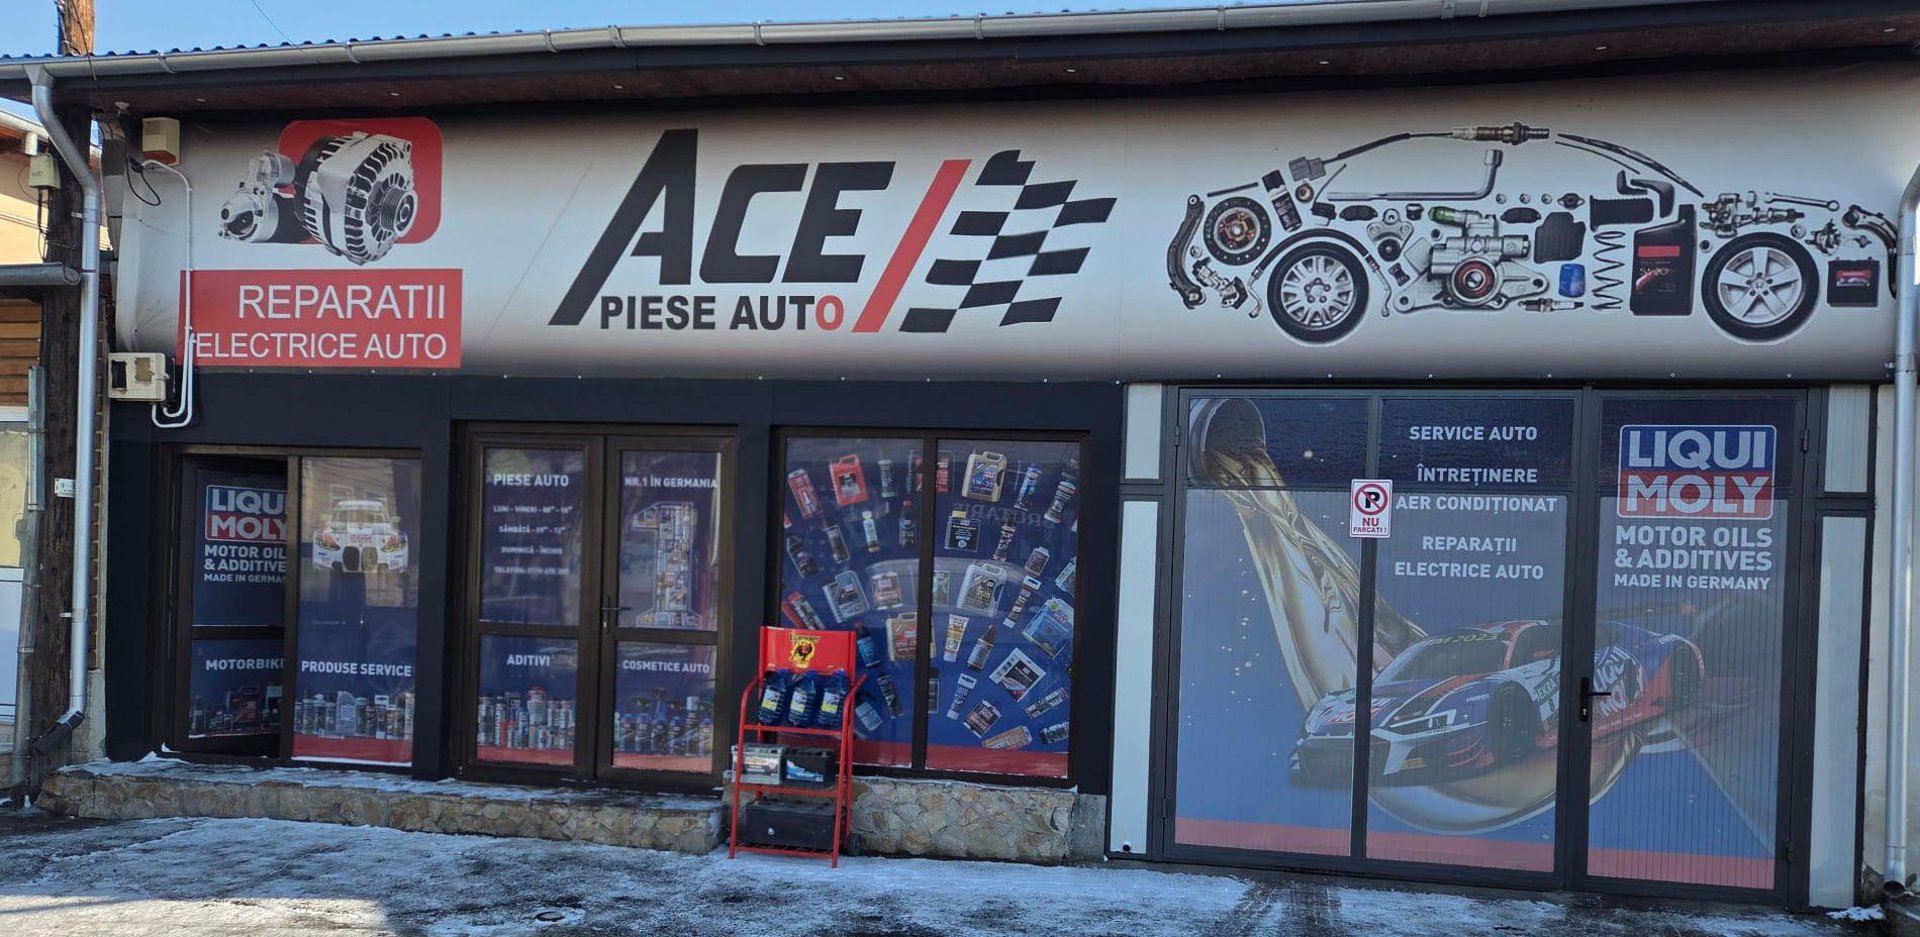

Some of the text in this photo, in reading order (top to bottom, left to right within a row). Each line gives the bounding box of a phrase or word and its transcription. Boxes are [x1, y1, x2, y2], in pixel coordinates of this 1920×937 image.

[547, 128, 896, 325] ACE
[239, 285, 445, 319] REPARATII
[601, 295, 844, 330] PIESE AUTO
[196, 333, 447, 360] ELECTRICE AUTO
[1409, 426, 1538, 441] SERVICE AUTO
[1628, 430, 1767, 470] LIQUI
[493, 473, 569, 487] PIESE AUTO
[663, 477, 717, 488] GERMANIA
[1627, 474, 1770, 514] MOLY
[1396, 496, 1431, 510] AER
[1362, 517, 1379, 527] NU
[1616, 525, 1773, 548] MOTOR OILS
[204, 544, 287, 559] MOTOR OIL
[1615, 548, 1773, 571] & ADDITIVES
[204, 558, 287, 573] & ADDITIVE
[1395, 562, 1543, 579] ELECTRICE AUTO
[204, 573, 287, 583] MADE IN GERMA
[1614, 573, 1770, 590] MADE IN GERMANY
[206, 658, 284, 671] MOTORBIK
[507, 654, 550, 666] ADITIVI
[622, 660, 709, 674] COSMETICE AUTO
[302, 660, 412, 677] PRODUSE SERVICE
